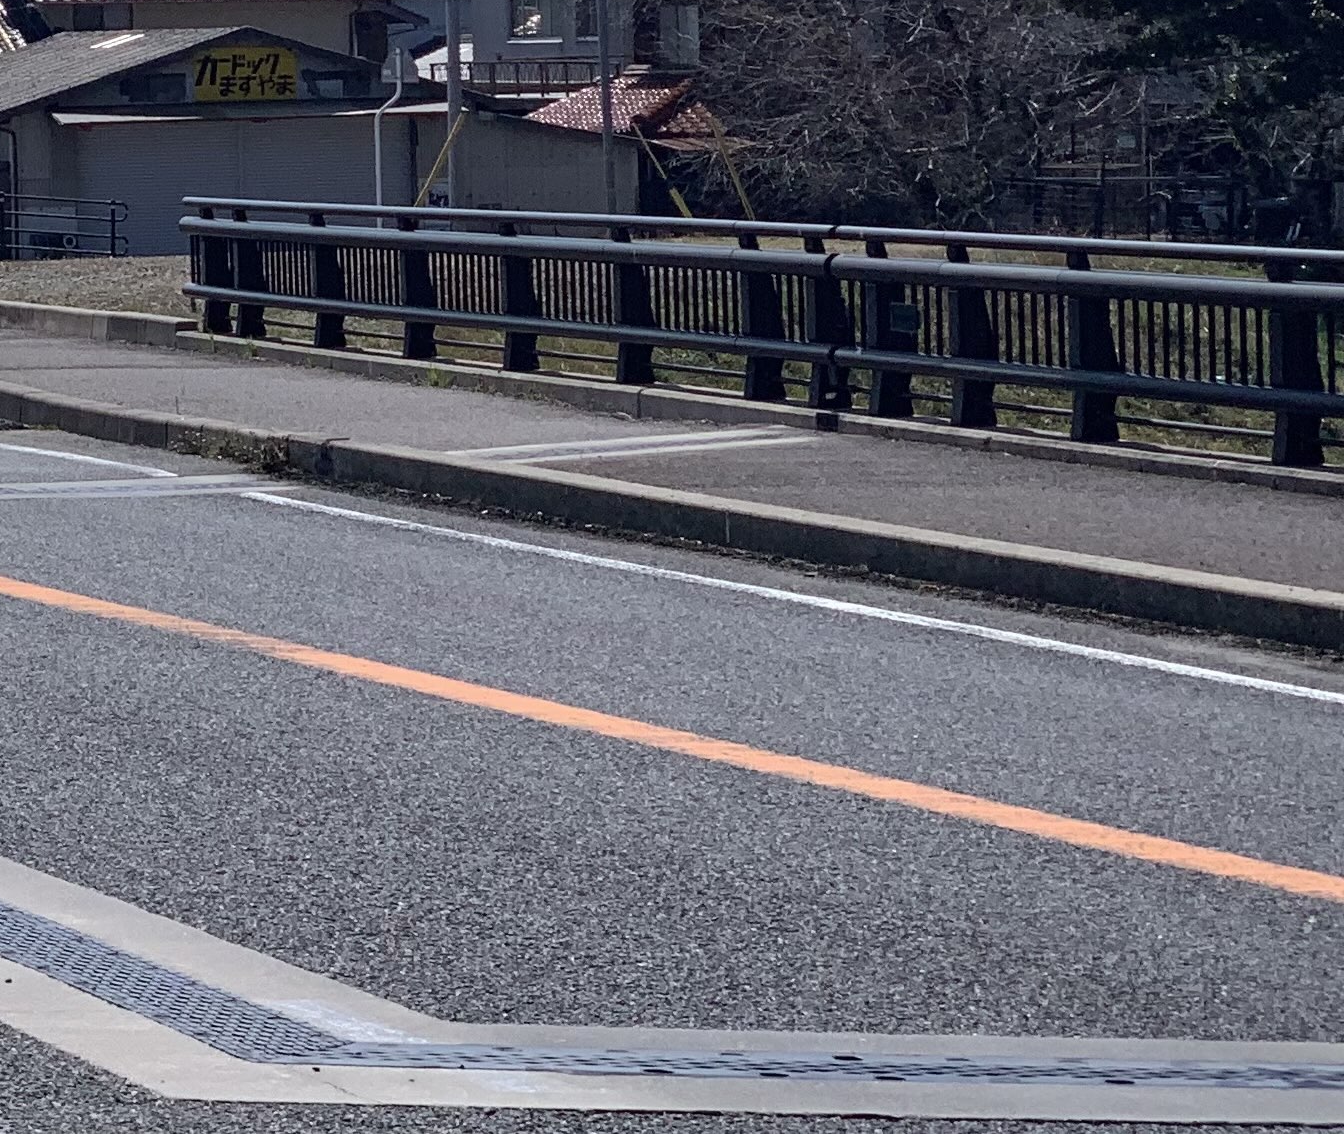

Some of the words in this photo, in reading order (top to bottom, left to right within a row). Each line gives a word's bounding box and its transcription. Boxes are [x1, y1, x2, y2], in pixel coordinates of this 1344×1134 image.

[194, 53, 281, 87] カードック
[219, 73, 295, 97] ますやま
